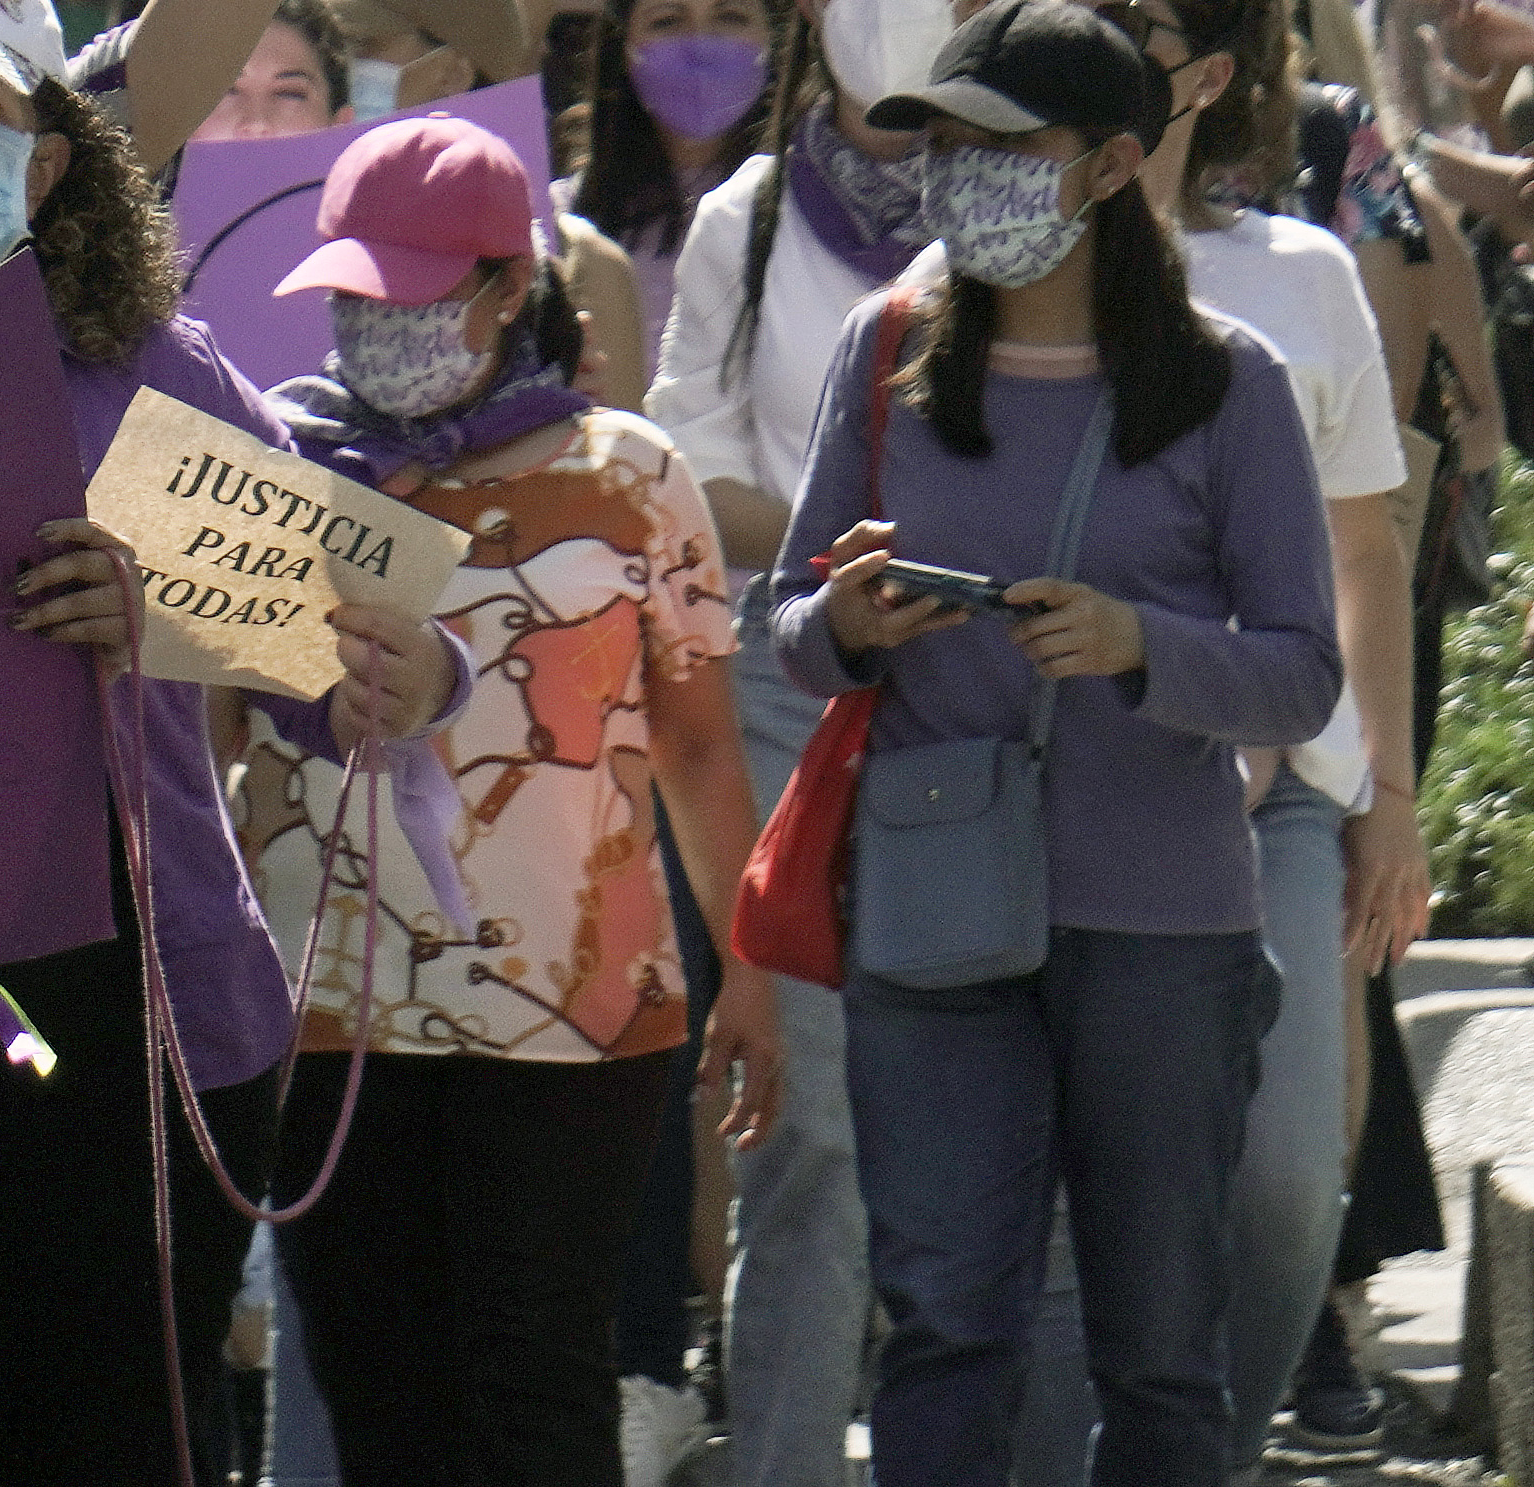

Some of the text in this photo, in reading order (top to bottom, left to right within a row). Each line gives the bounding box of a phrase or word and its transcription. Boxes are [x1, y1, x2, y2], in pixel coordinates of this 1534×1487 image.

[166, 451, 396, 579] ¡JUSTICIA
[183, 526, 315, 583] PARA
[138, 566, 304, 630] TODAS!
